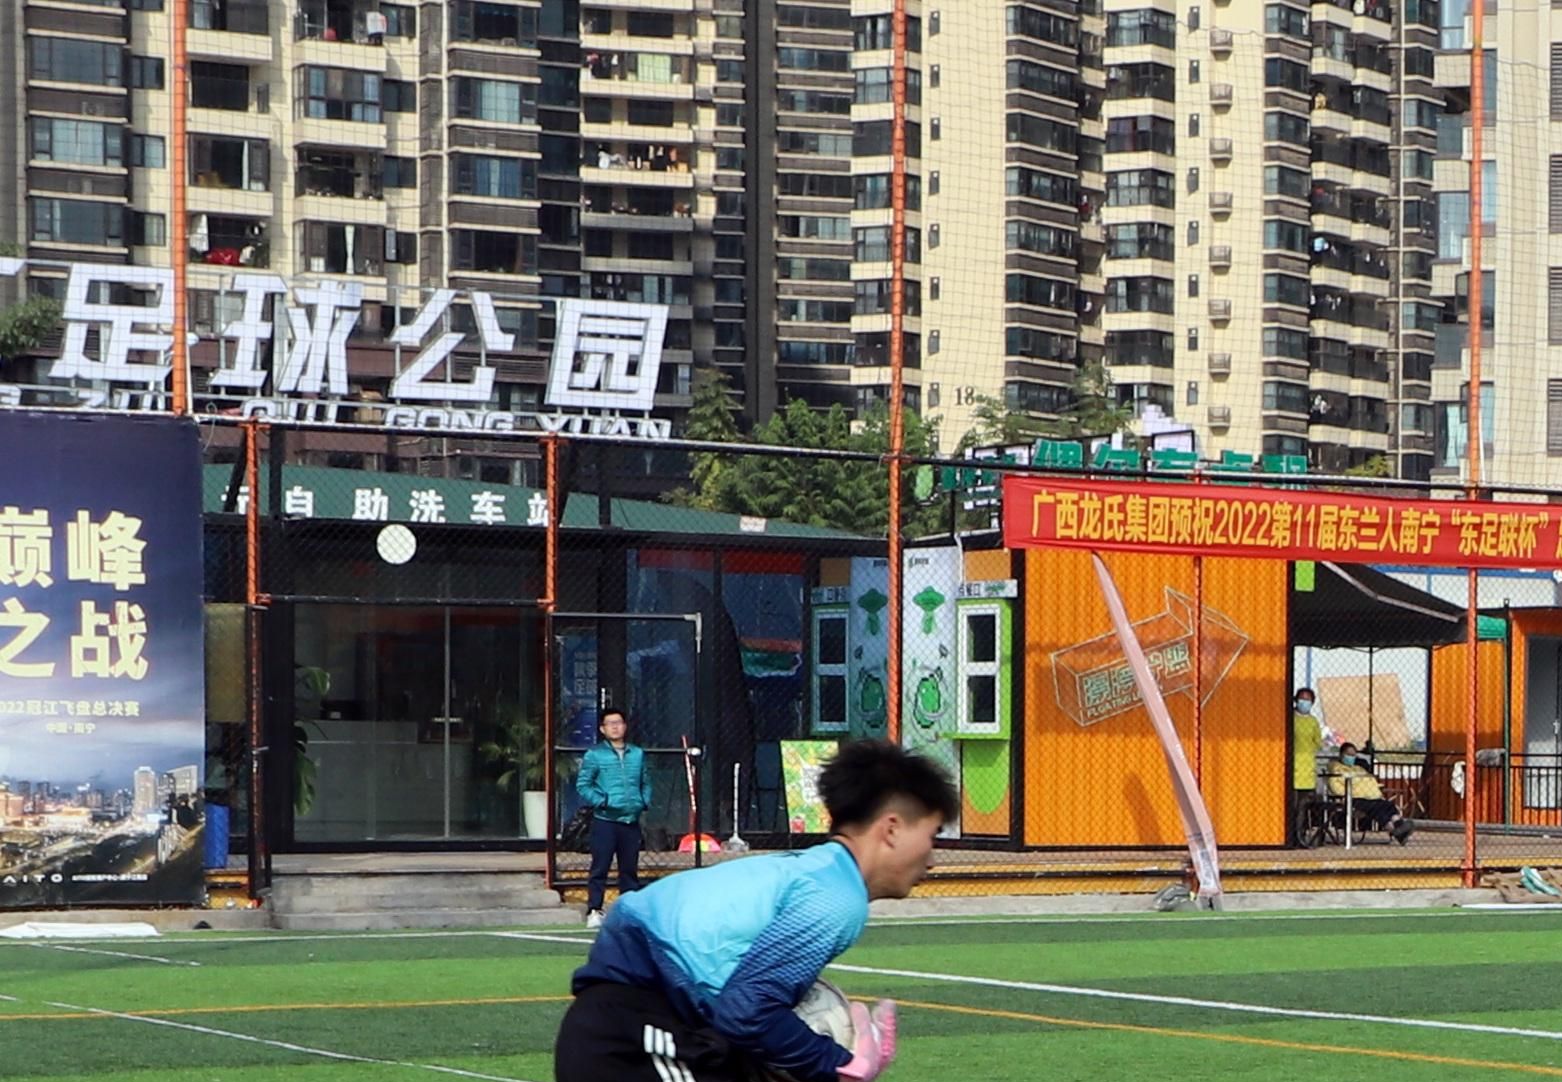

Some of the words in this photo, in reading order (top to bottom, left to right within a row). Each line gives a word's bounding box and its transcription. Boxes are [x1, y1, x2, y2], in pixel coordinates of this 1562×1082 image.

[0, 257, 669, 410] 足球公园
[954, 386, 975, 406] 18
[384, 406, 514, 431] GONG
[536, 414, 671, 440] YUAN
[0, 597, 148, 680] 之战
[3, 874, 63, 884] AITO
